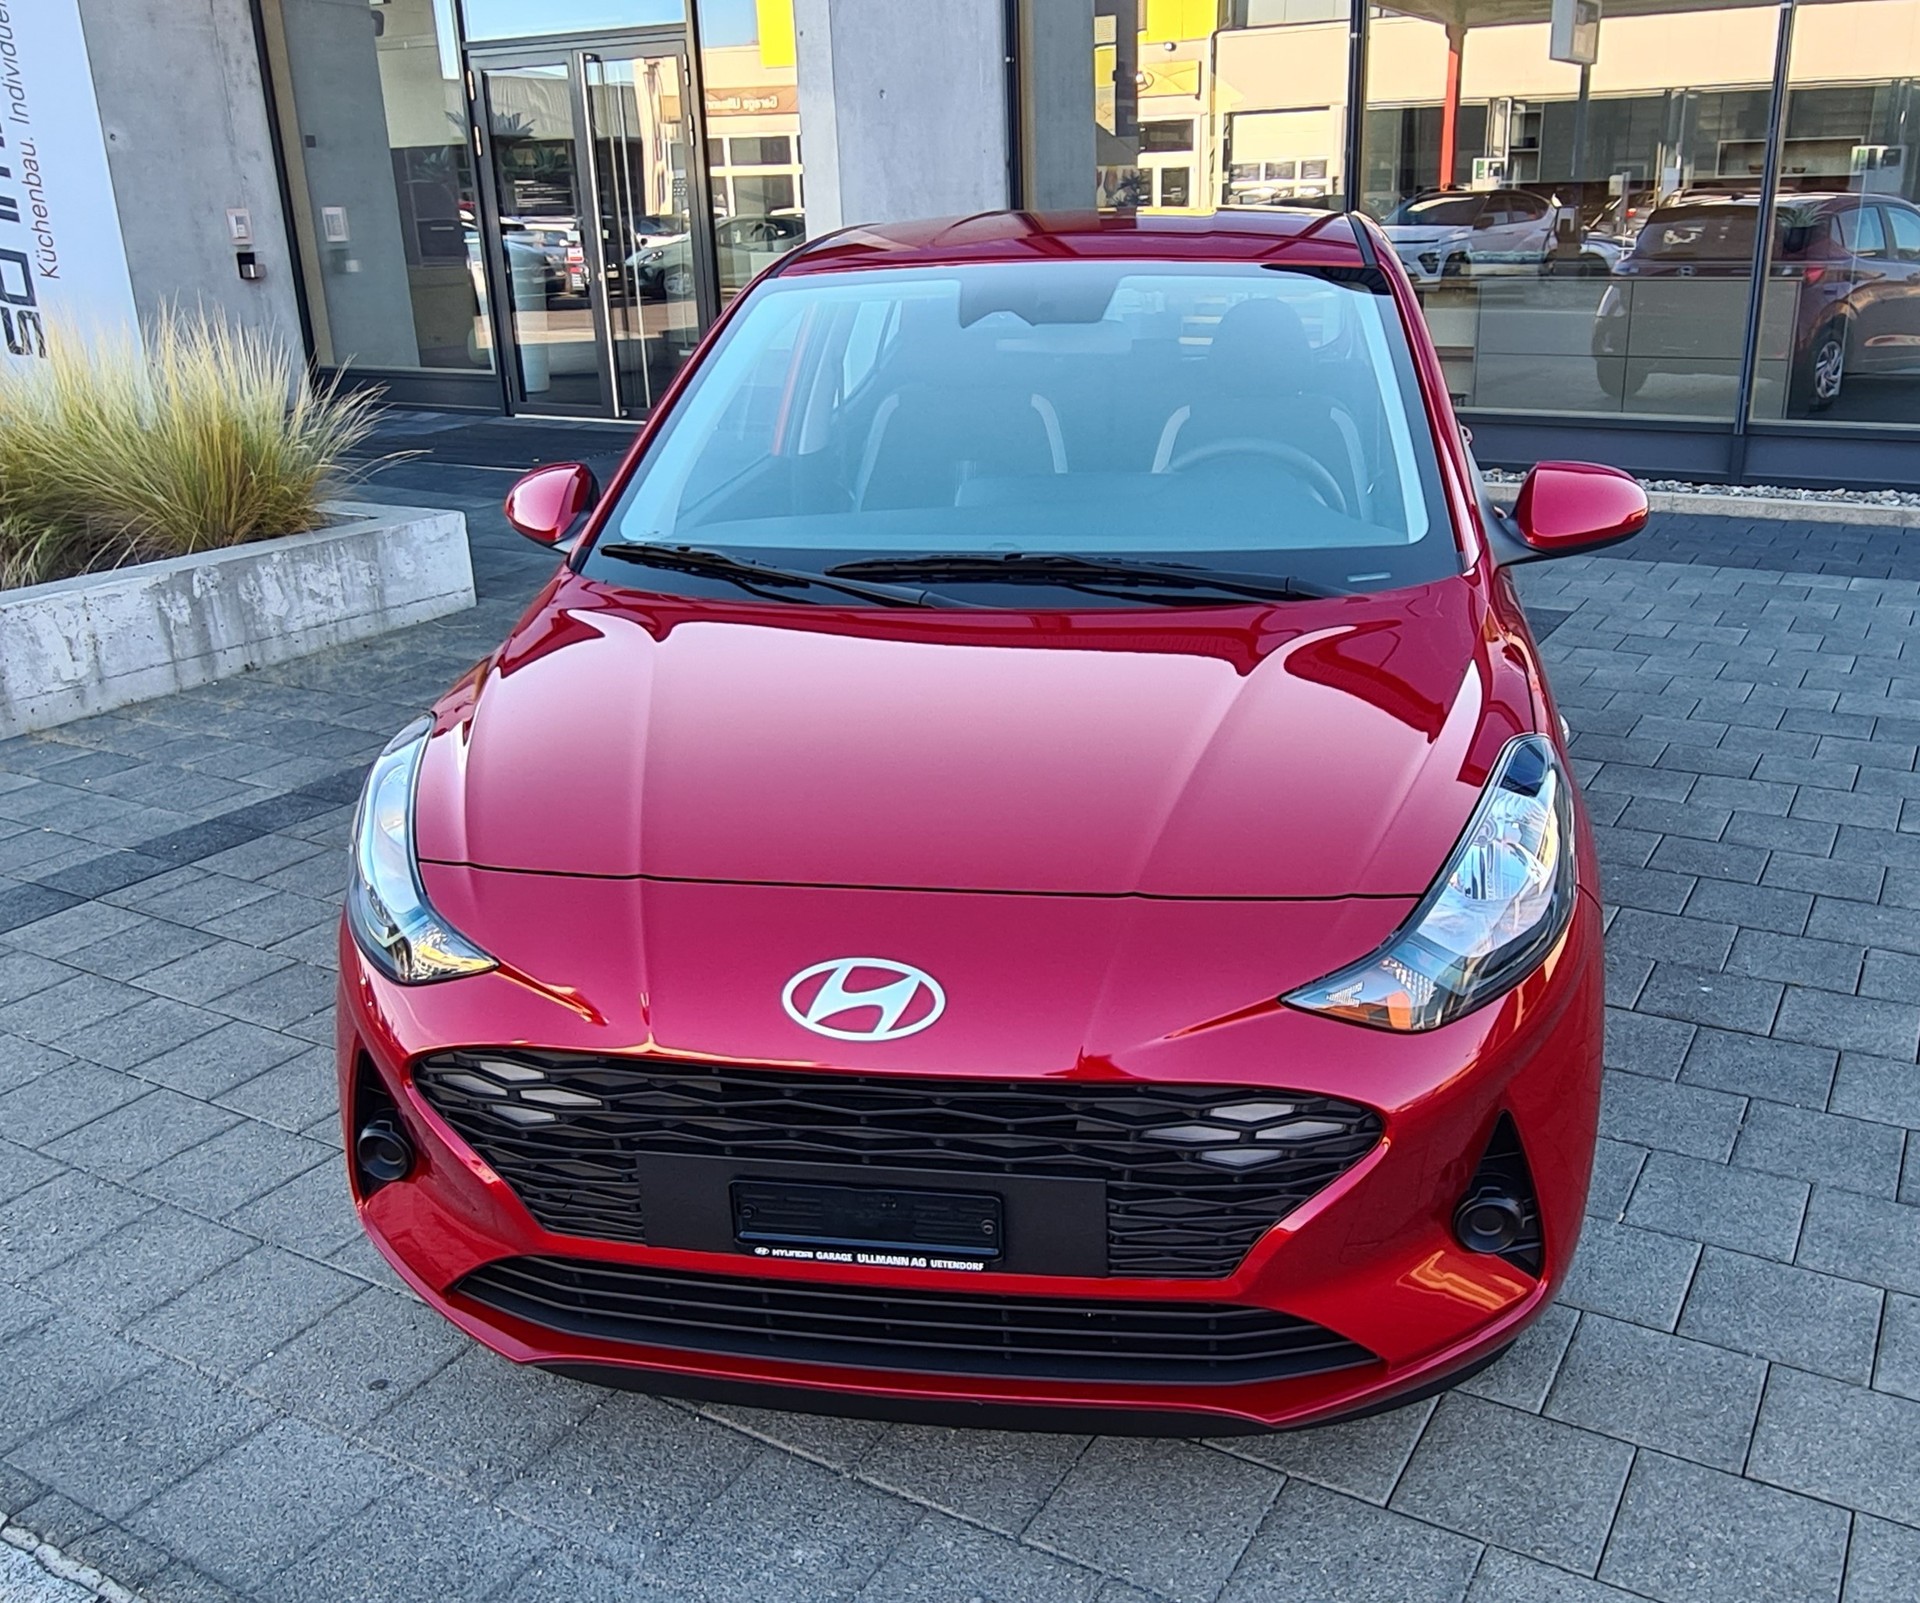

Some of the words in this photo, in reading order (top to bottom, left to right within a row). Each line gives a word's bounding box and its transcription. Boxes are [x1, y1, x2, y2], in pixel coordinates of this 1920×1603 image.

[20, 136, 60, 279] Küchenbau.
[816, 1251, 852, 1262] GARAGE
[857, 1254, 909, 1266] ULLMANN
[911, 1258, 927, 1267] AG
[930, 1260, 984, 1271] UETENDORF
